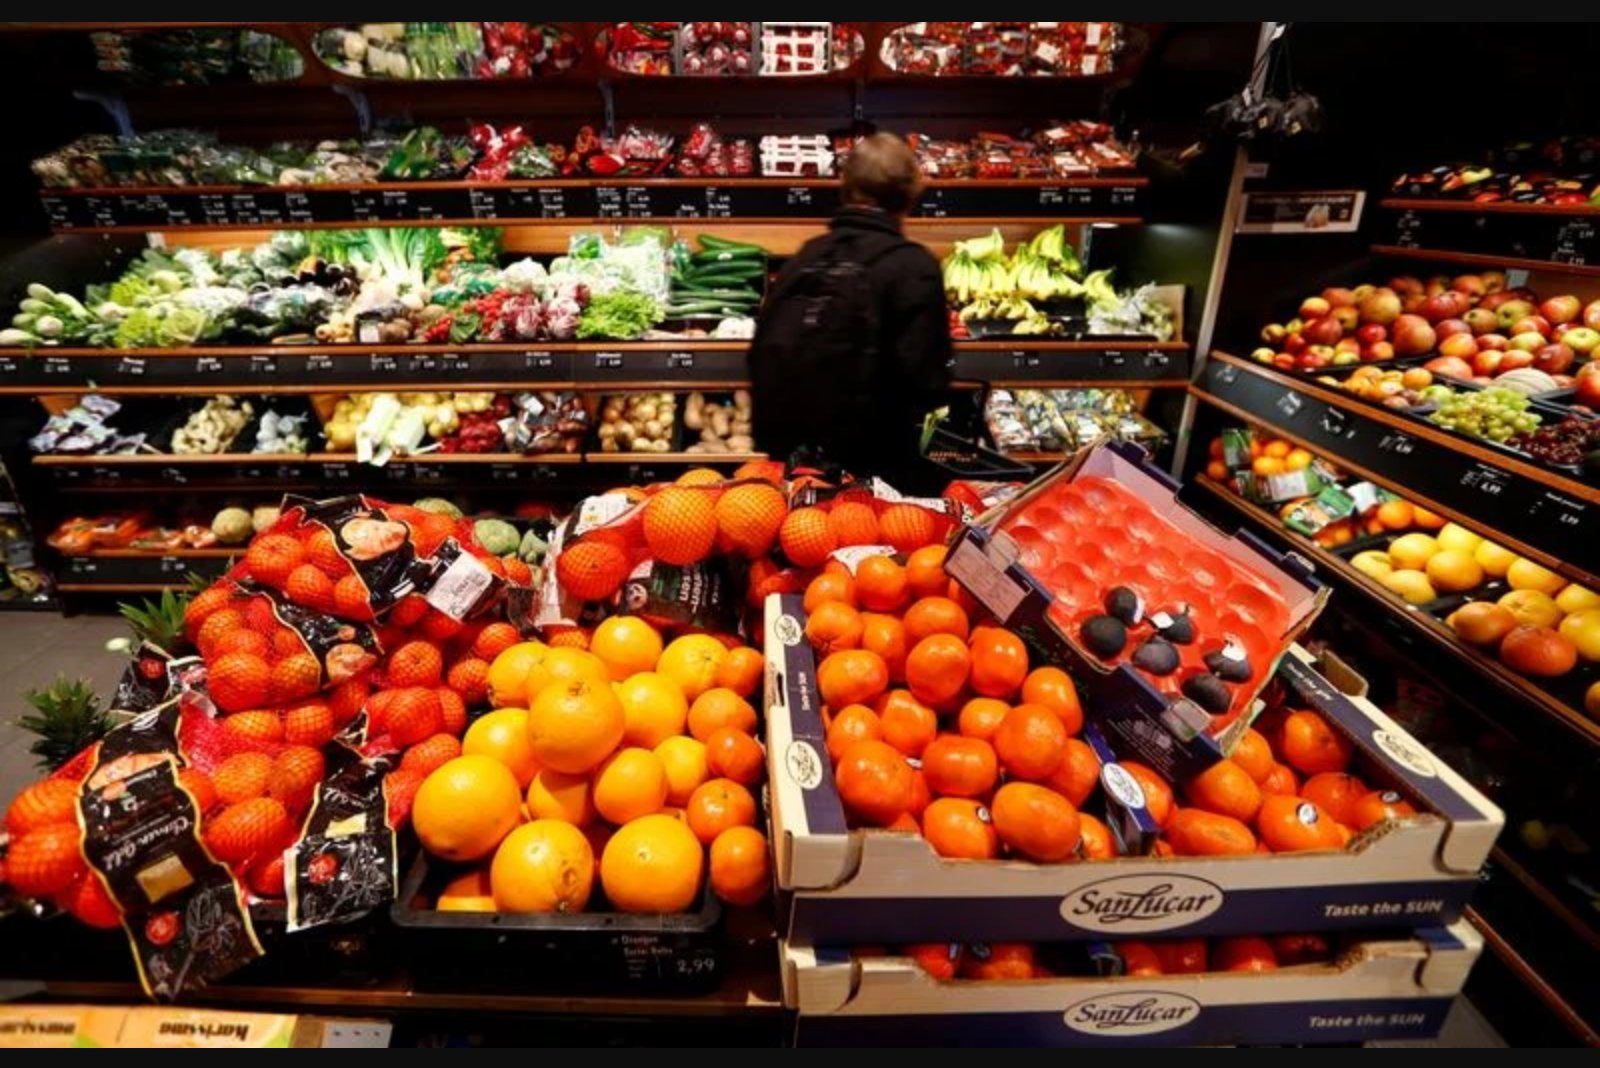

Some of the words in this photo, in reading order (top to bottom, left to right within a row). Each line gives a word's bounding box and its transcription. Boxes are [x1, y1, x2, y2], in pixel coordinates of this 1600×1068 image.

[1072, 884, 1214, 924] SanLucar
[1325, 904, 1369, 917] Taste
[1373, 902, 1401, 914] the
[1405, 900, 1443, 913] SUN
[1074, 998, 1192, 1029] SanLucar
[1310, 1016, 1353, 1028] Taste
[1356, 1014, 1384, 1026] the
[1389, 1013, 1424, 1025] SUN
